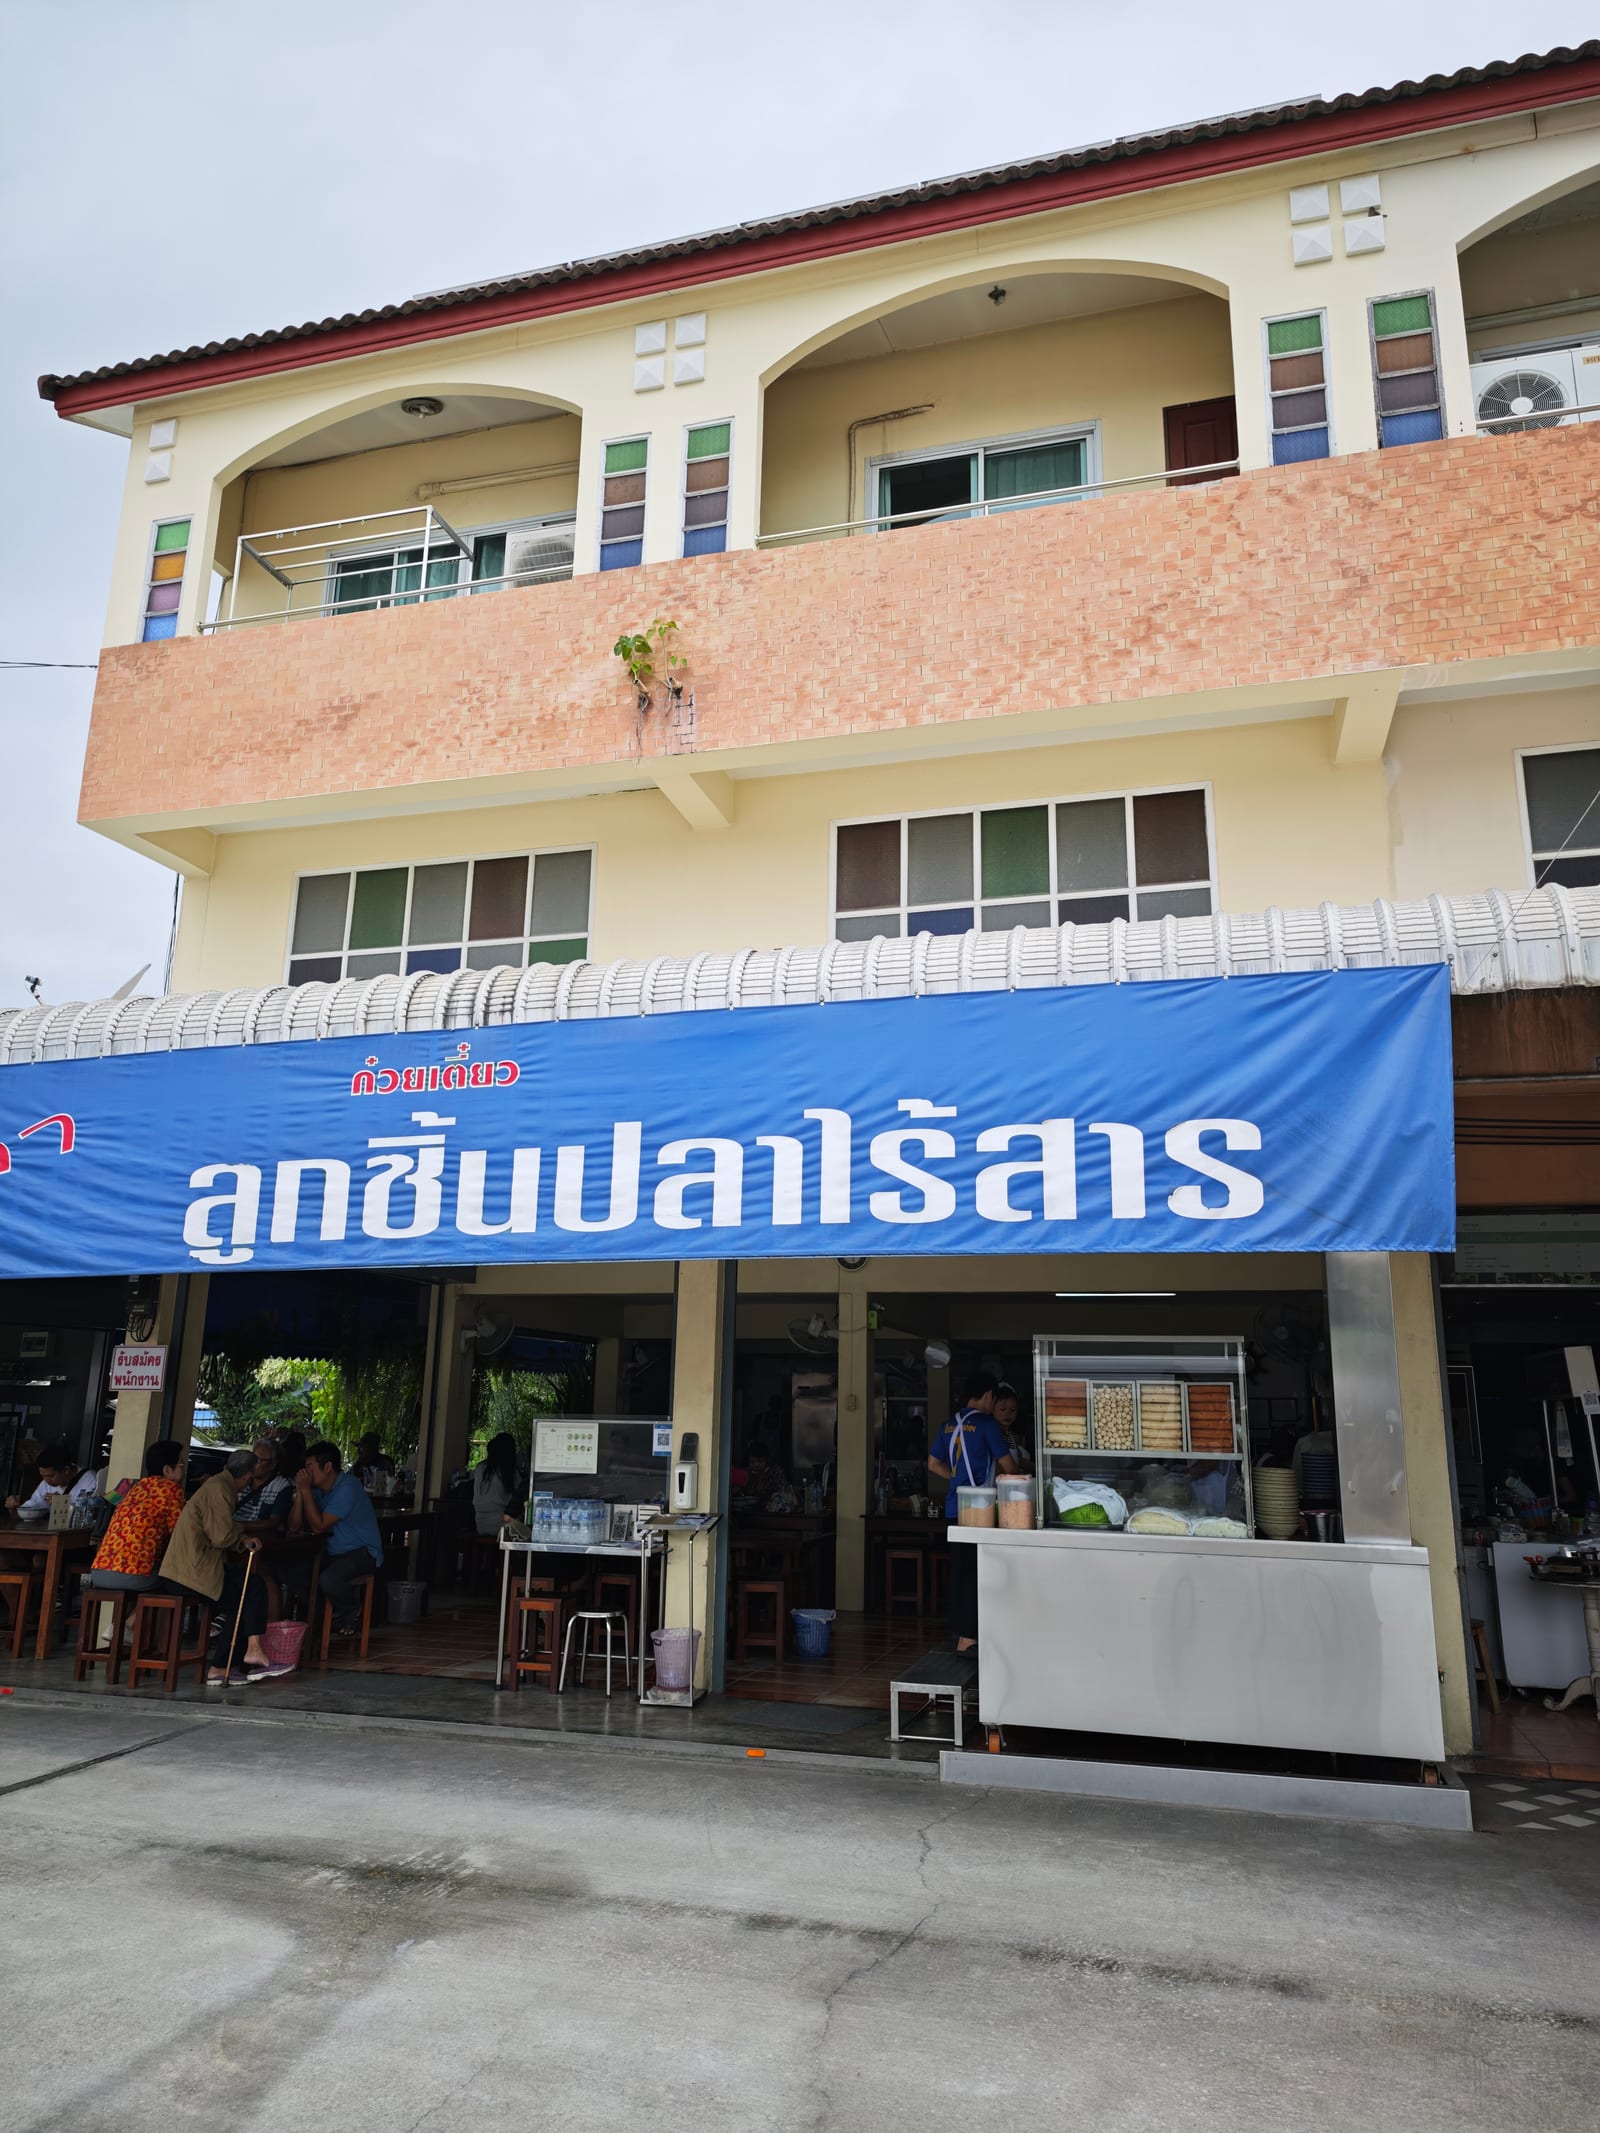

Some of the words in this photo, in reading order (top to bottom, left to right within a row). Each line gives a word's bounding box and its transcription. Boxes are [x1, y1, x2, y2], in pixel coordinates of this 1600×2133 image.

[351, 1042, 520, 1096] ก๋วยเตี๋ยว
[183, 1099, 1264, 1264] ลูกชิ้นปลาไร้สาร
[117, 1350, 161, 1366] รับสมัคร
[114, 1370, 159, 1386] พนักงาน
